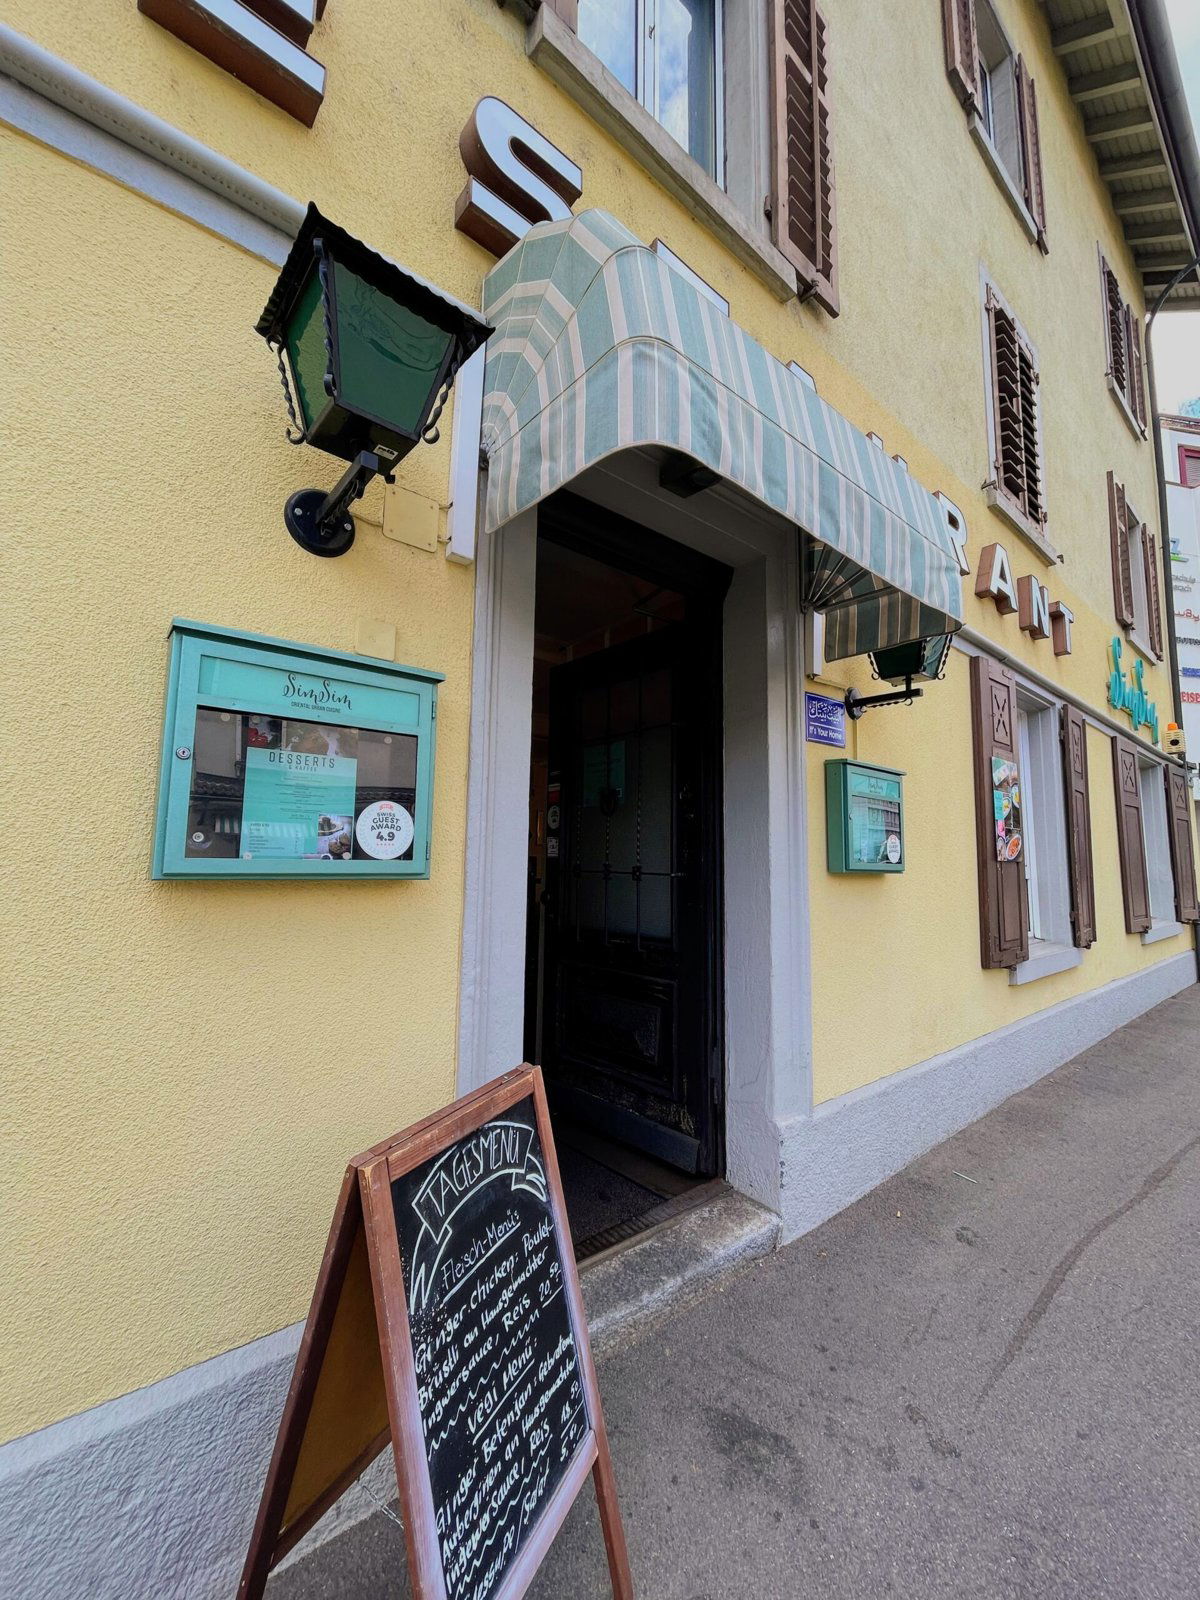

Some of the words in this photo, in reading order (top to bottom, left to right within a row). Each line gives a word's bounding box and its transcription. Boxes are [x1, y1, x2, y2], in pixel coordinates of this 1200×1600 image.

[282, 673, 352, 710] SimSim
[817, 727, 828, 737] Your
[828, 730, 842, 740] Home
[268, 752, 335, 768] DESSERTS
[370, 823, 402, 831] AWARD
[376, 831, 395, 841] 4.9
